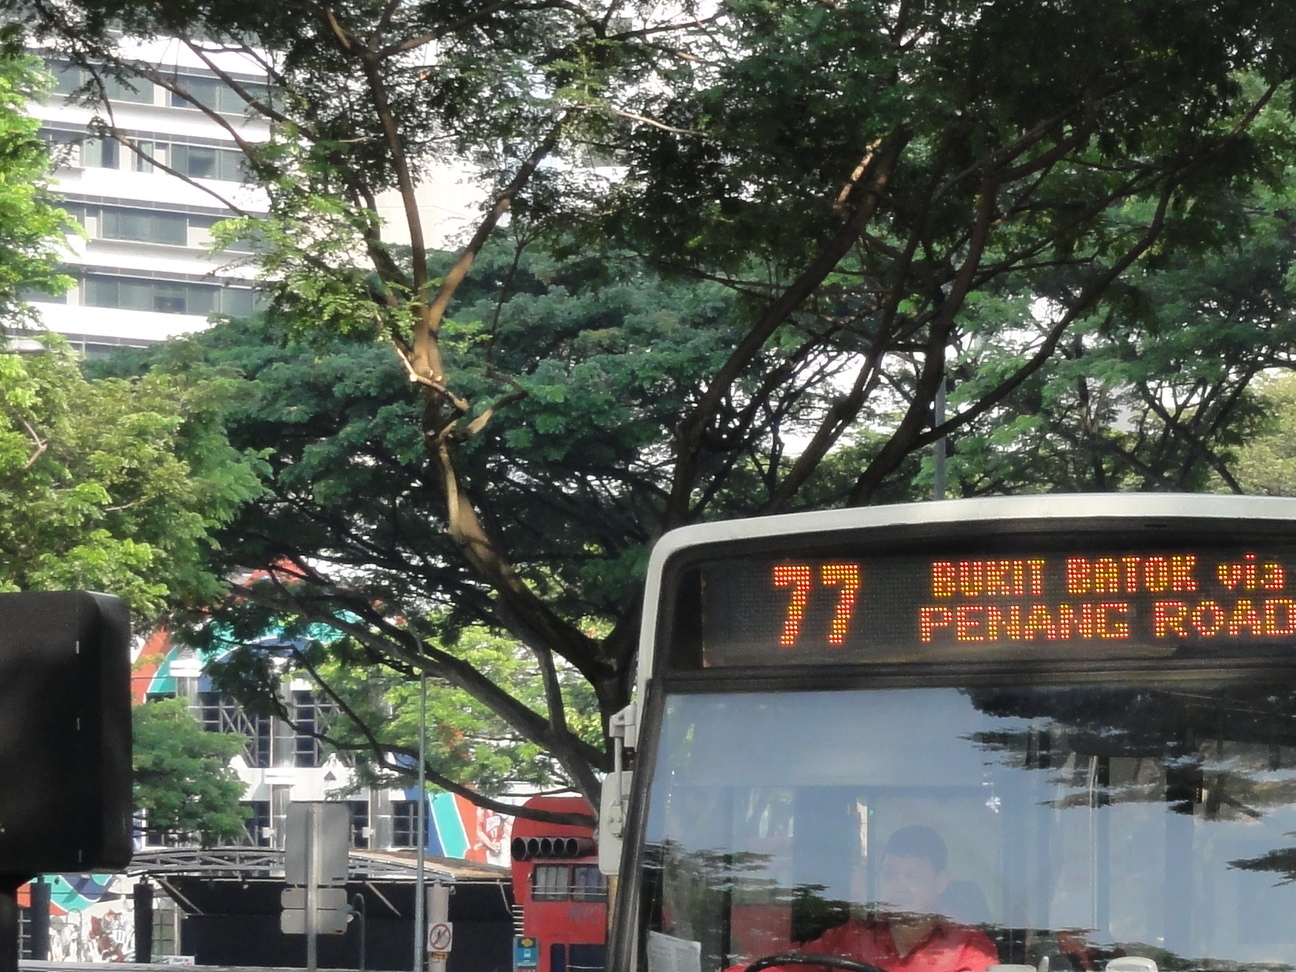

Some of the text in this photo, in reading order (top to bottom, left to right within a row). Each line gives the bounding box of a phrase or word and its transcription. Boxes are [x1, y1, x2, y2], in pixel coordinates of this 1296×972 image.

[931, 552, 1284, 598] BUKIT BATOK via
[774, 563, 860, 646] 77
[919, 603, 1129, 643] PENANG
